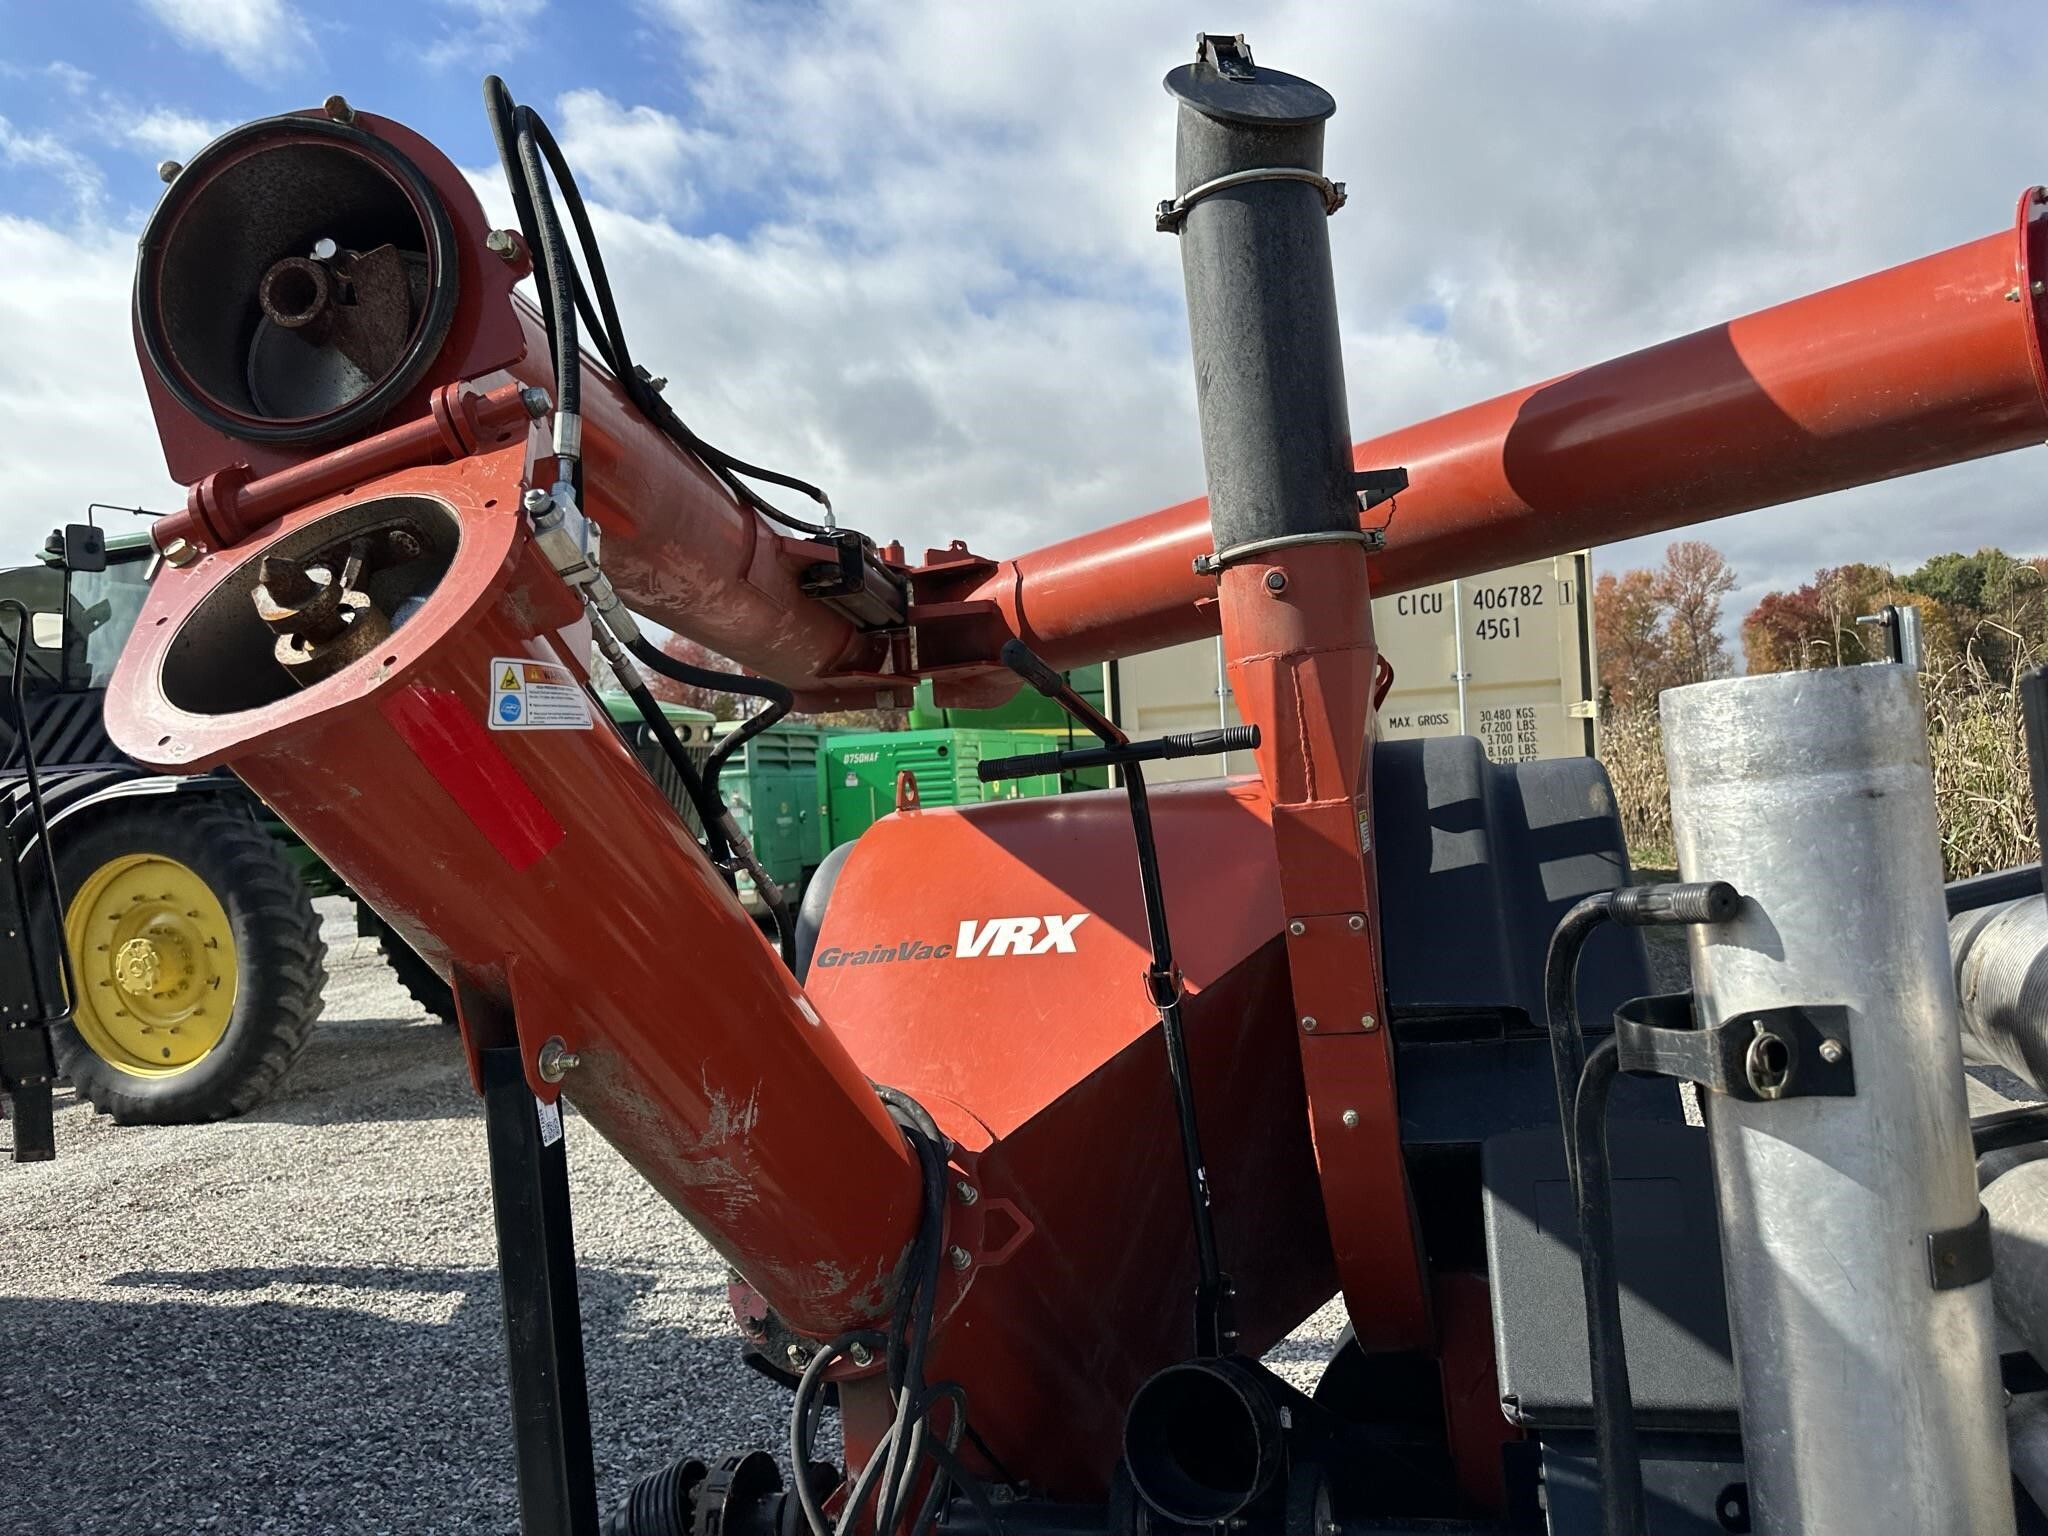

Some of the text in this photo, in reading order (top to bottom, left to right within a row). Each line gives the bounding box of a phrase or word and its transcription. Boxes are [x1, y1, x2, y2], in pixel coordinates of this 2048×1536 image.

[1398, 582, 1570, 616] CICU 406782 1
[1476, 617, 1520, 640] 45G1
[1417, 714, 1449, 727] GROSS
[1480, 708, 1511, 722] 30.480
[1480, 721, 1512, 734] 67.200
[1487, 732, 1513, 745] 3.700
[1487, 744, 1514, 757] 8.160
[816, 912, 1091, 968] GrainVac VRX
